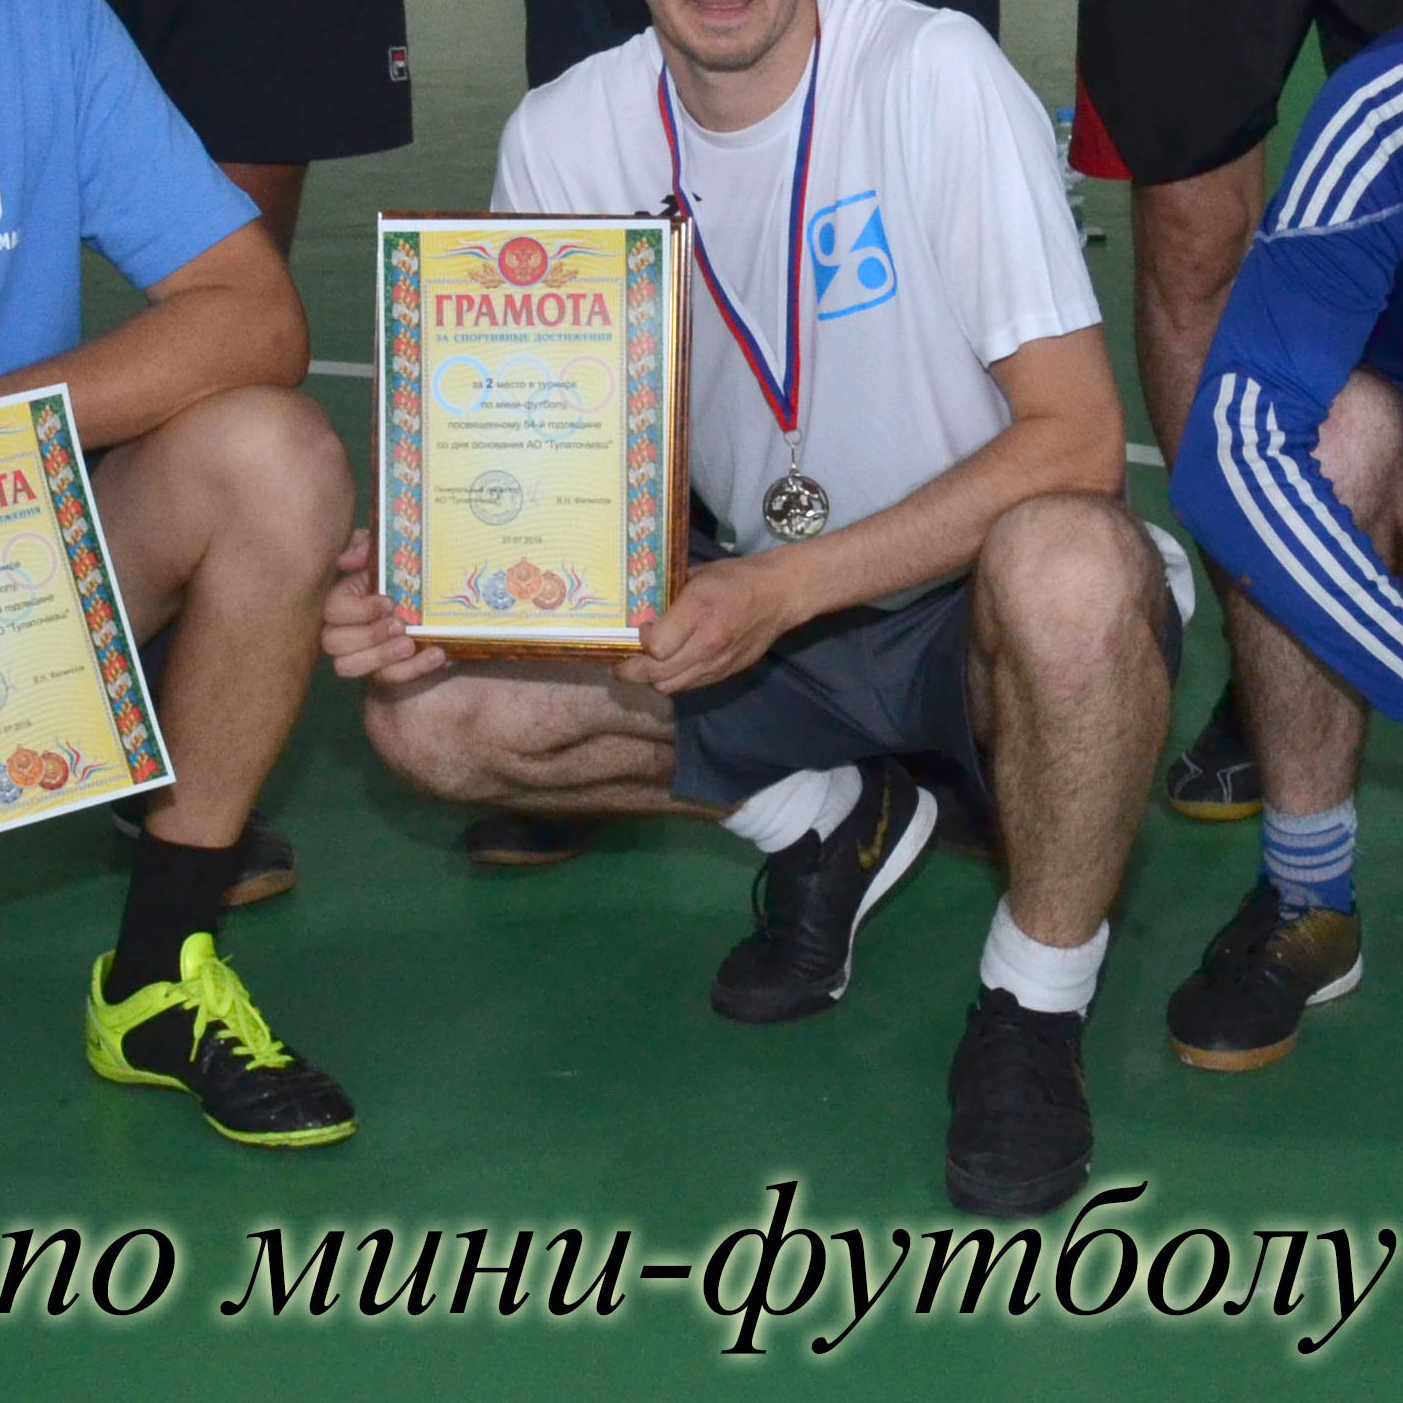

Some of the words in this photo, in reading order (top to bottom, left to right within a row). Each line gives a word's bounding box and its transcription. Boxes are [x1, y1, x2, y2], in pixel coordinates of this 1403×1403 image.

[435, 292, 611, 327] ГРАМОТА
[454, 333, 528, 342] СПОРТИВНЫЕ
[533, 332, 612, 342] ДОСТИЖЕНИЯ
[486, 379, 492, 388] 2
